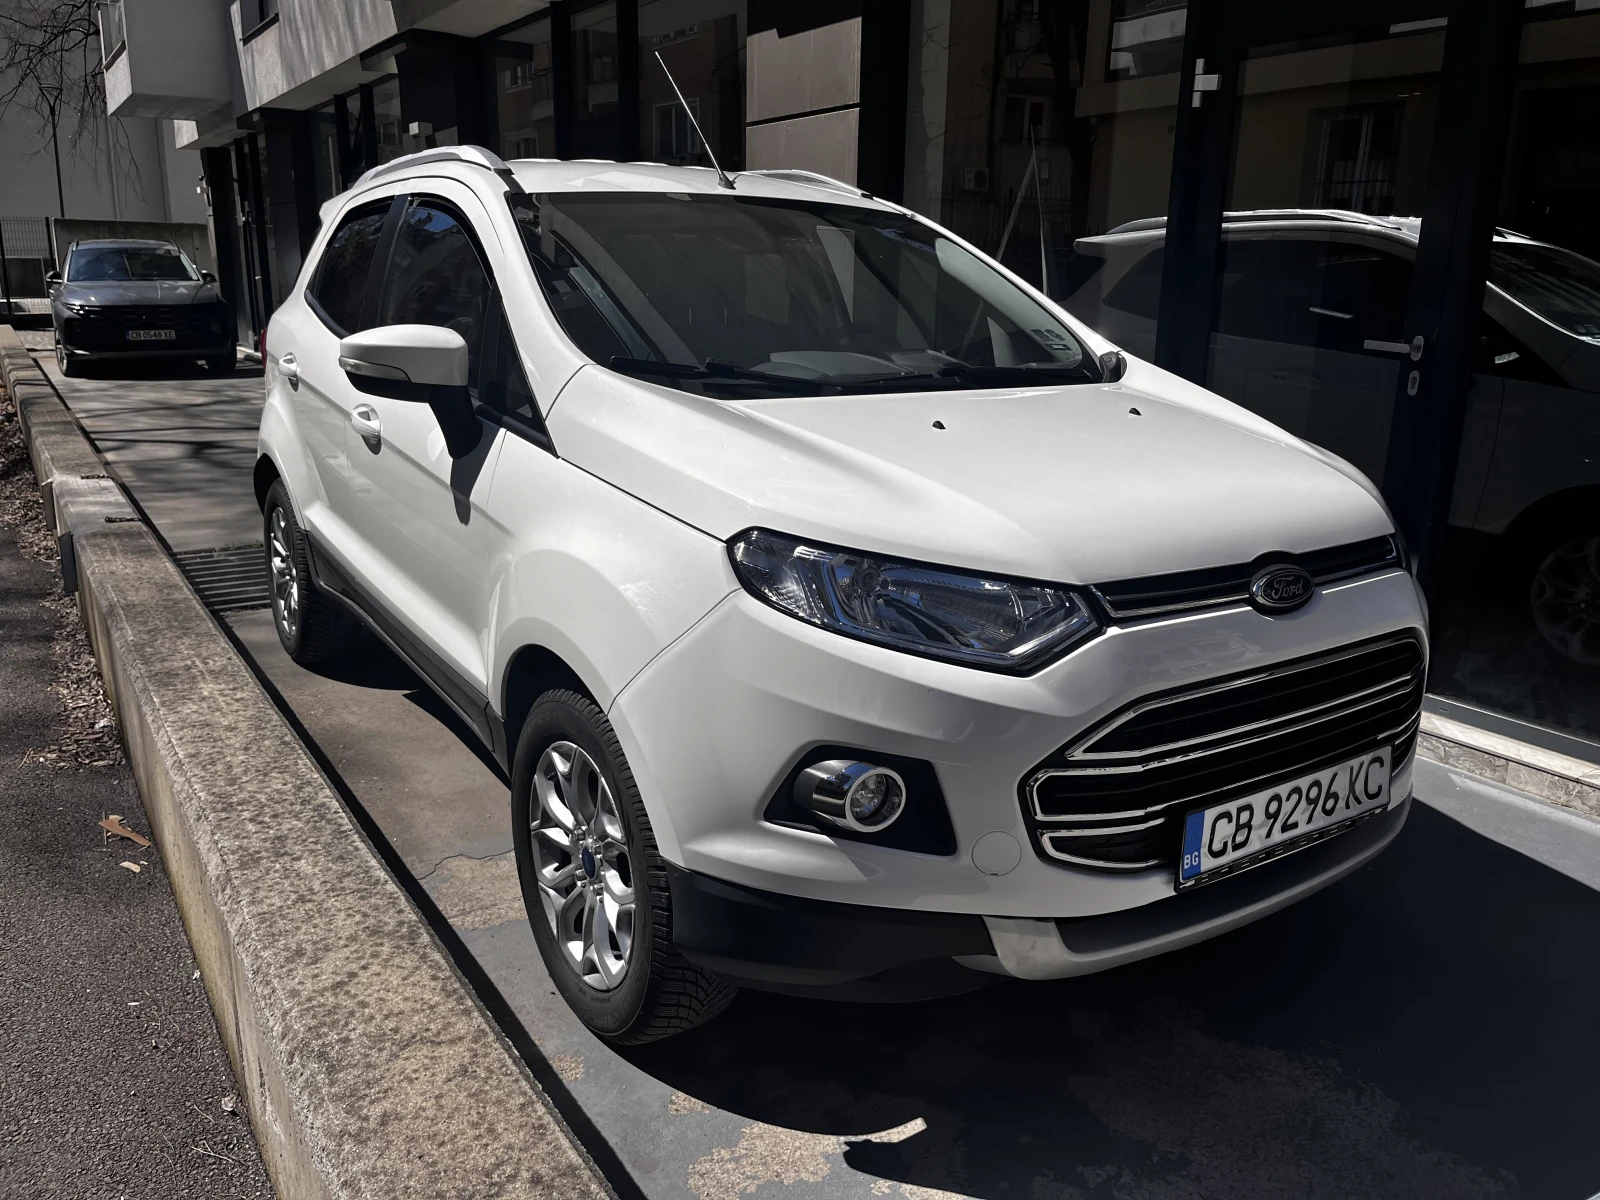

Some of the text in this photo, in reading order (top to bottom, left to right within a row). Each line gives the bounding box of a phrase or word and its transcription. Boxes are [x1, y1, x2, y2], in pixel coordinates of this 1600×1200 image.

[131, 331, 141, 339] CB
[1271, 576, 1304, 600] Ford
[1207, 756, 1385, 859] CB 9296 KC
[1183, 851, 1200, 869] BG
